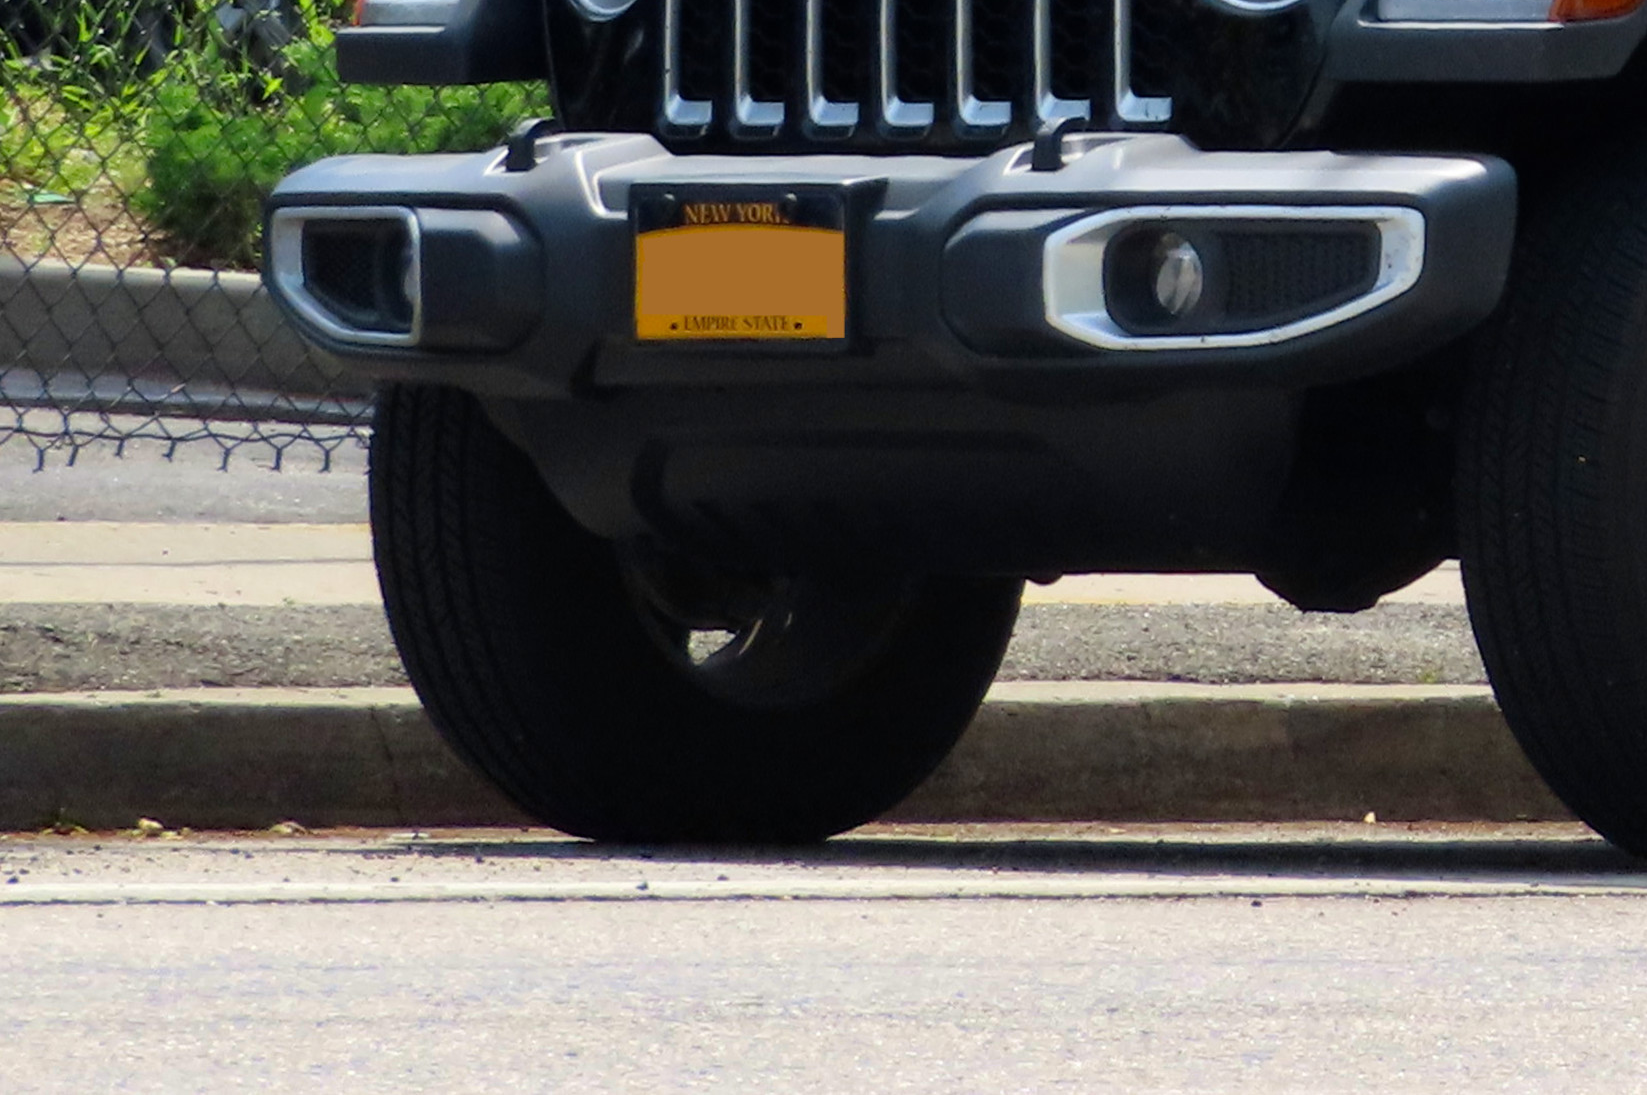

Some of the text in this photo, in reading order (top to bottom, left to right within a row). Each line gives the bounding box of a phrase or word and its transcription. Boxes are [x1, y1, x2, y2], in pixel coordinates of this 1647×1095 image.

[684, 203, 731, 225] NEW
[683, 315, 788, 331] EMPIRE STATE
